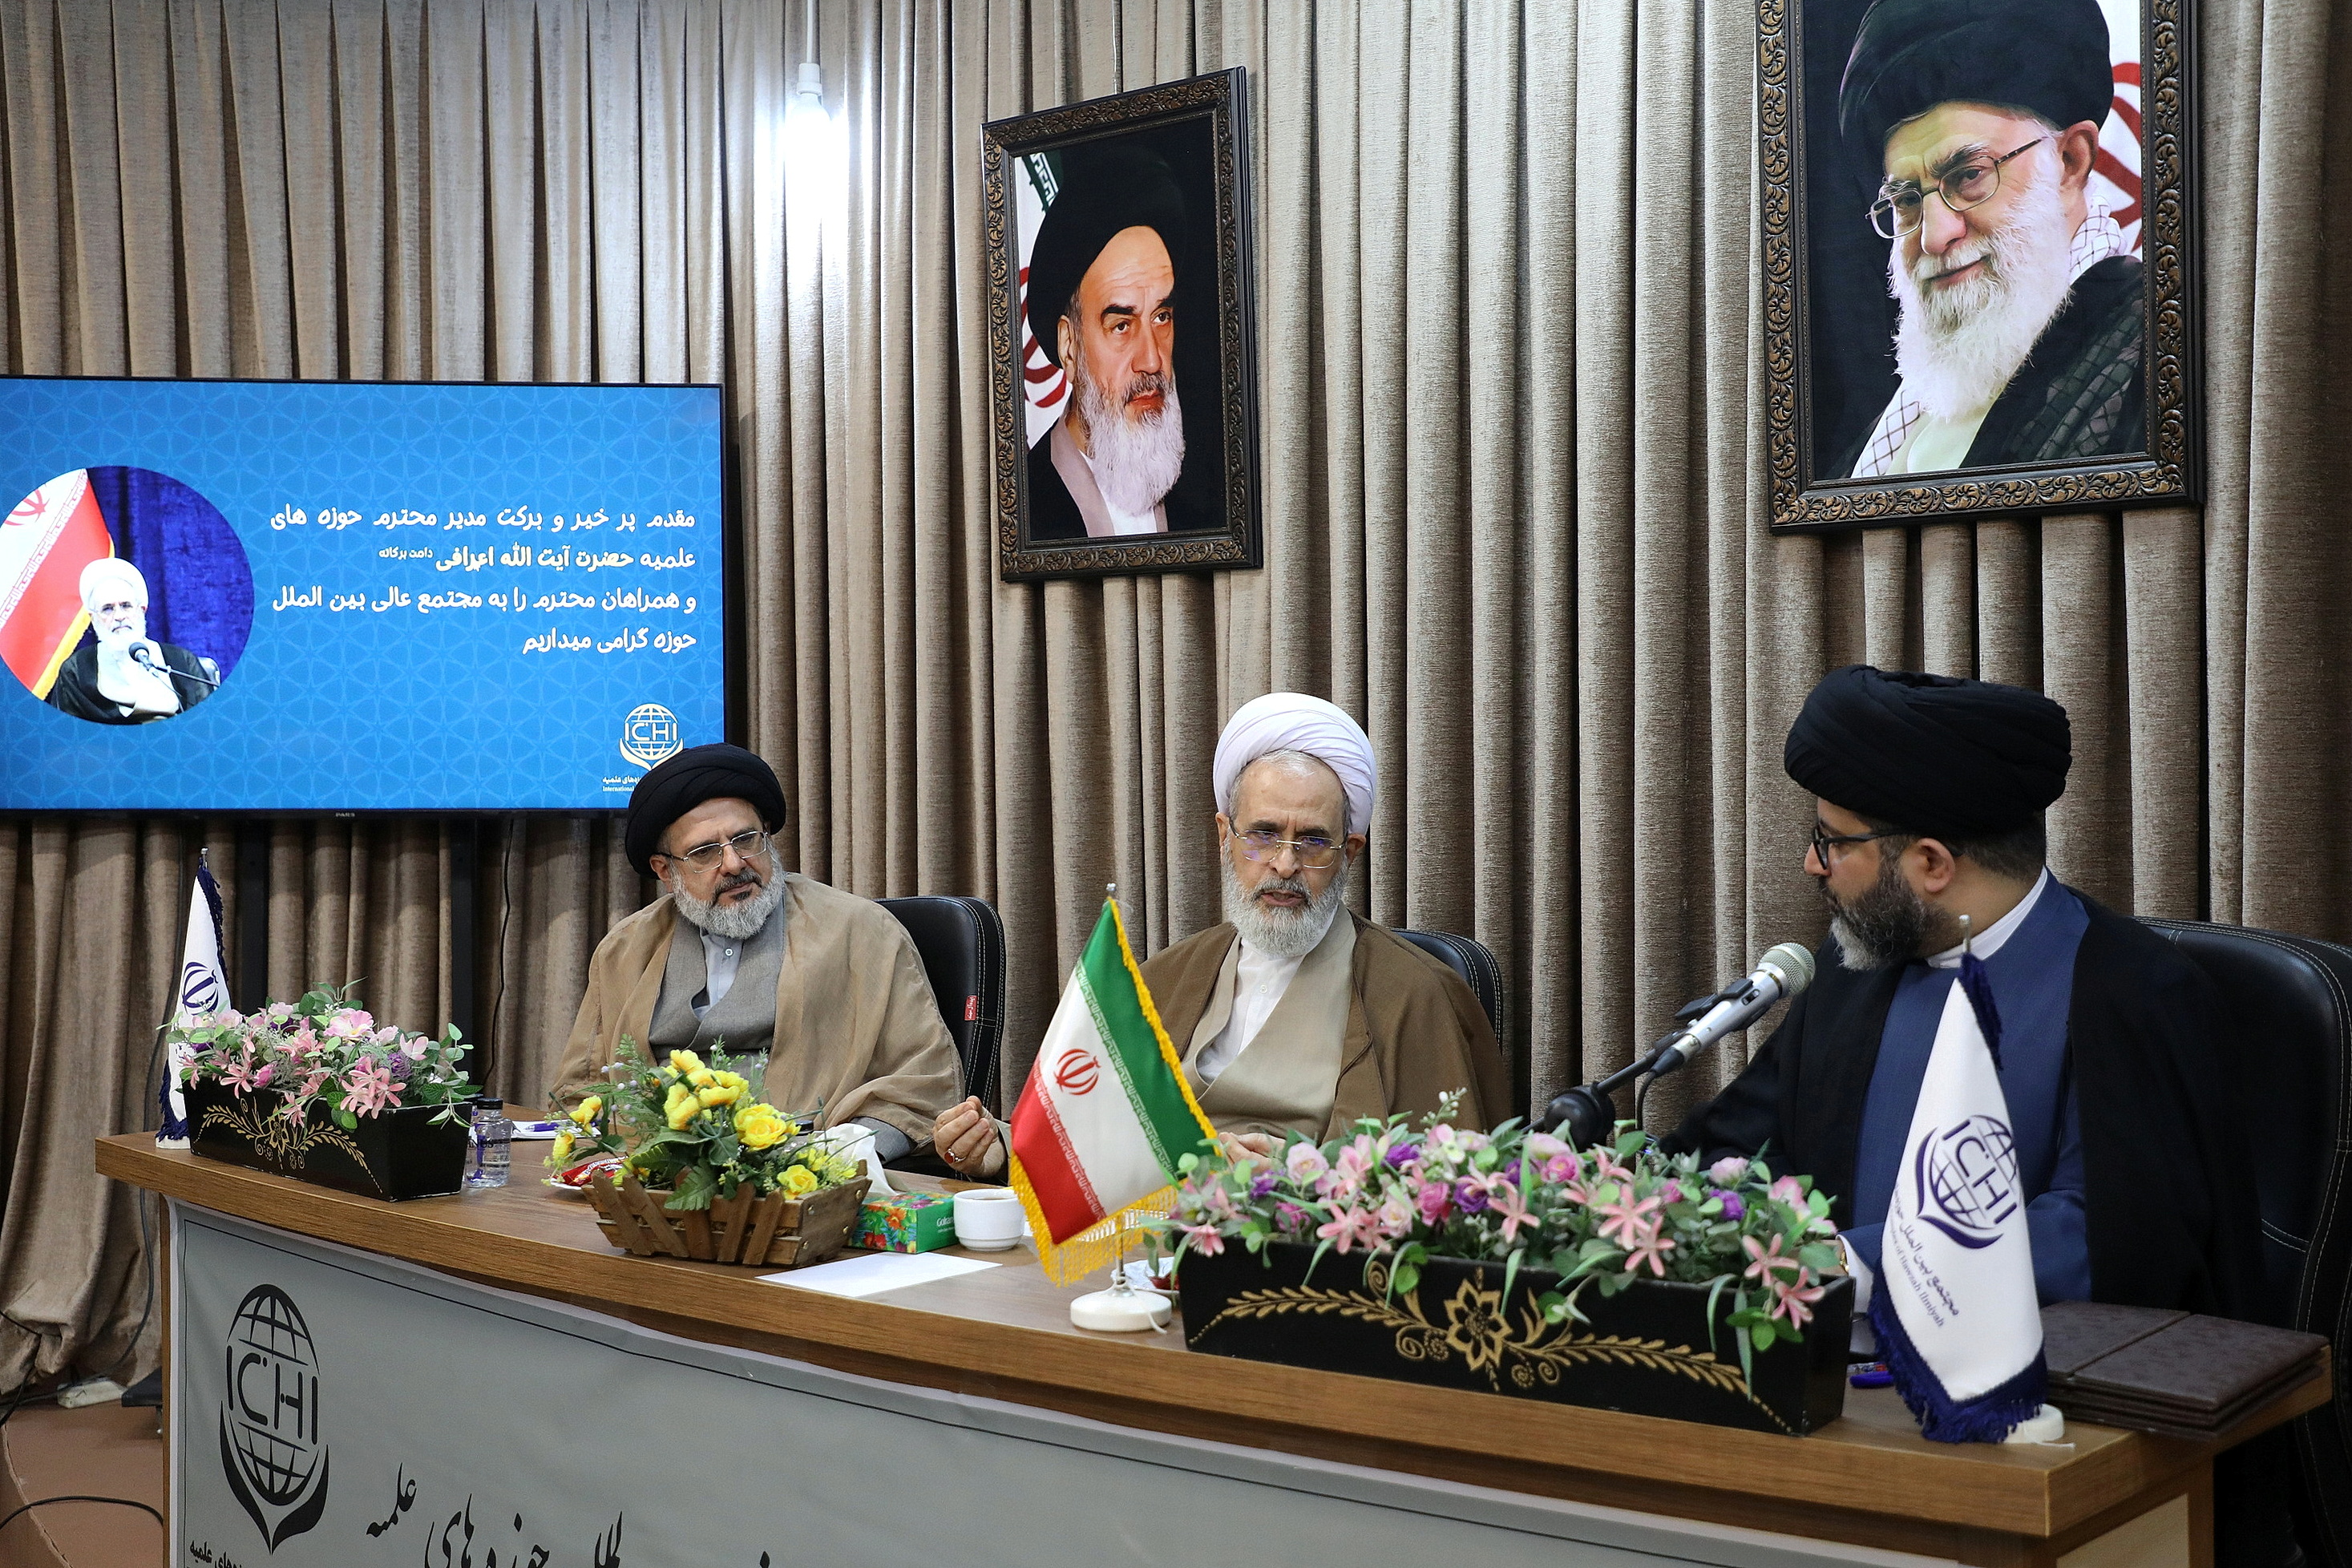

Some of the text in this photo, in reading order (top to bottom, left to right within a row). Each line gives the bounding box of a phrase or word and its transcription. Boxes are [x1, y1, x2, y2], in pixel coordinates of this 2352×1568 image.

[271, 503, 696, 533] مقدم پر خیر و برکت مدیر محترم حوزه های
[408, 547, 434, 559] دامت
[435, 542, 696, 572] علمیه حضرت آیت الله اعرافی
[273, 585, 697, 614] و همراهان محترم را به مجتمع عالی بین الملل
[522, 627, 697, 654] حوزه گرامی میداریم
[624, 721, 678, 742] ICHI
[1943, 1119, 2017, 1224] ICHI
[1899, 1224, 1923, 1252] الملل
[1914, 1255, 1932, 1275] بین
[1926, 1275, 1959, 1316] مجتمع
[226, 1345, 318, 1445] ICHI
